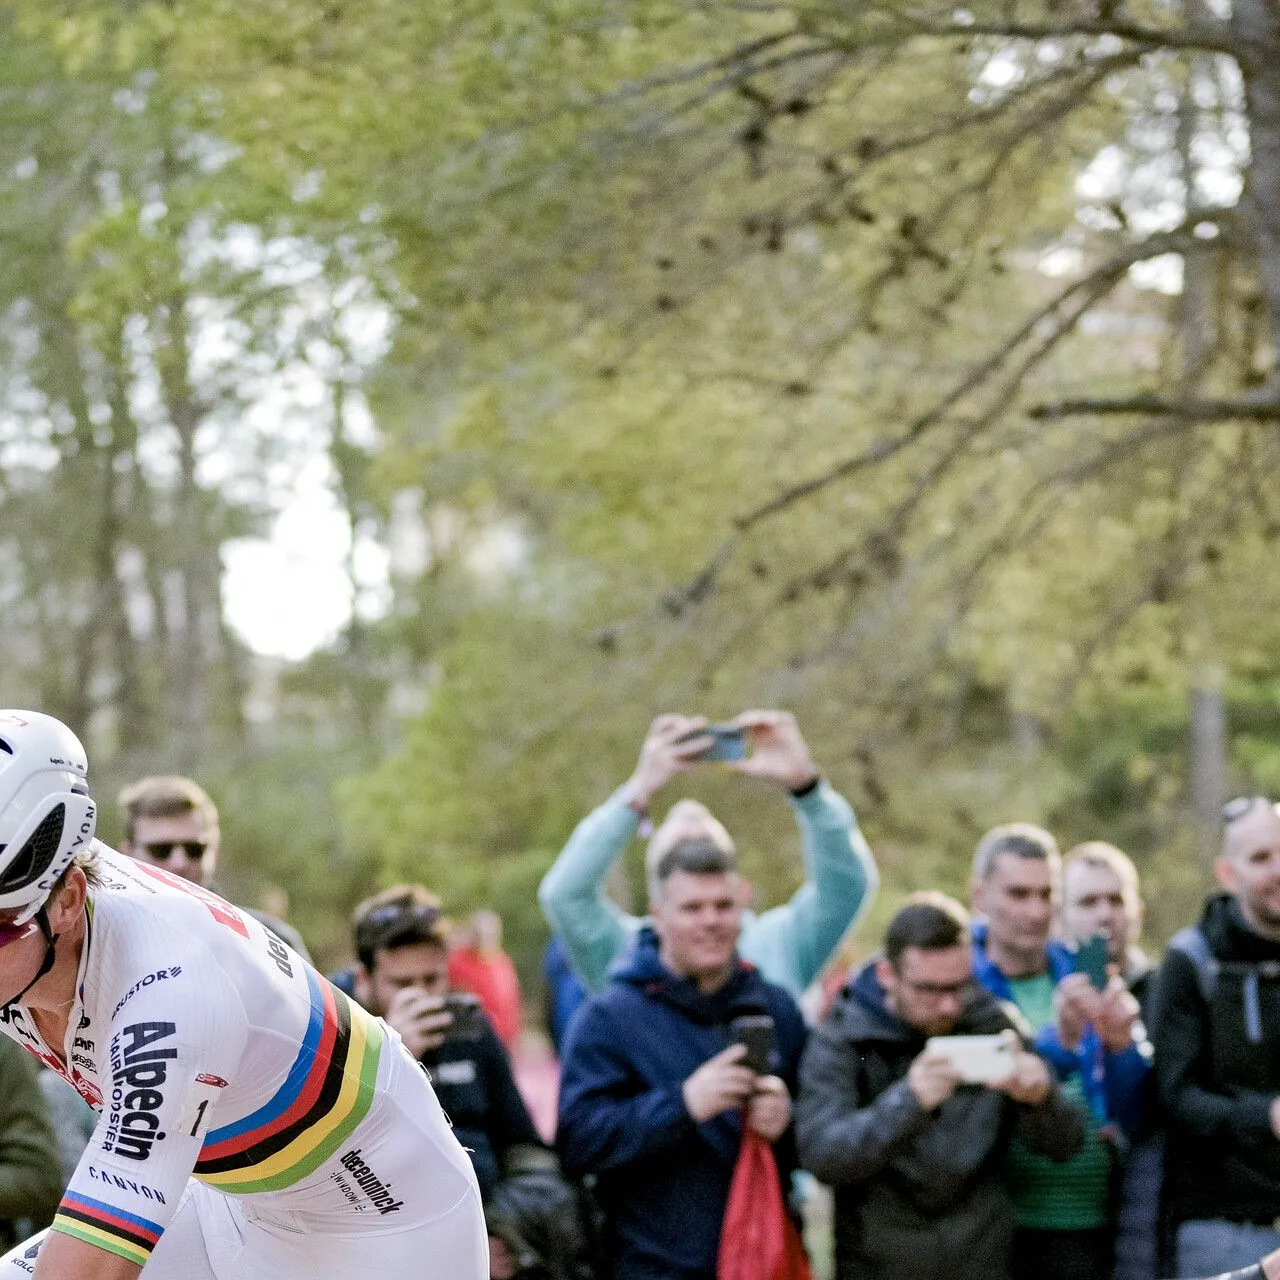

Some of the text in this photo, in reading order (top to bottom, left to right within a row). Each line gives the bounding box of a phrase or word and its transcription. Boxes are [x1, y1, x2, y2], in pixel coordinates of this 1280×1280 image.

[109, 1032, 123, 1073] HAIR
[115, 1021, 178, 1161] Alpecin
[190, 1099, 209, 1137] 1
[89, 1165, 167, 1206] CANYON
[340, 1148, 404, 1215] deceuninck
[10, 1256, 35, 1274] KALA
